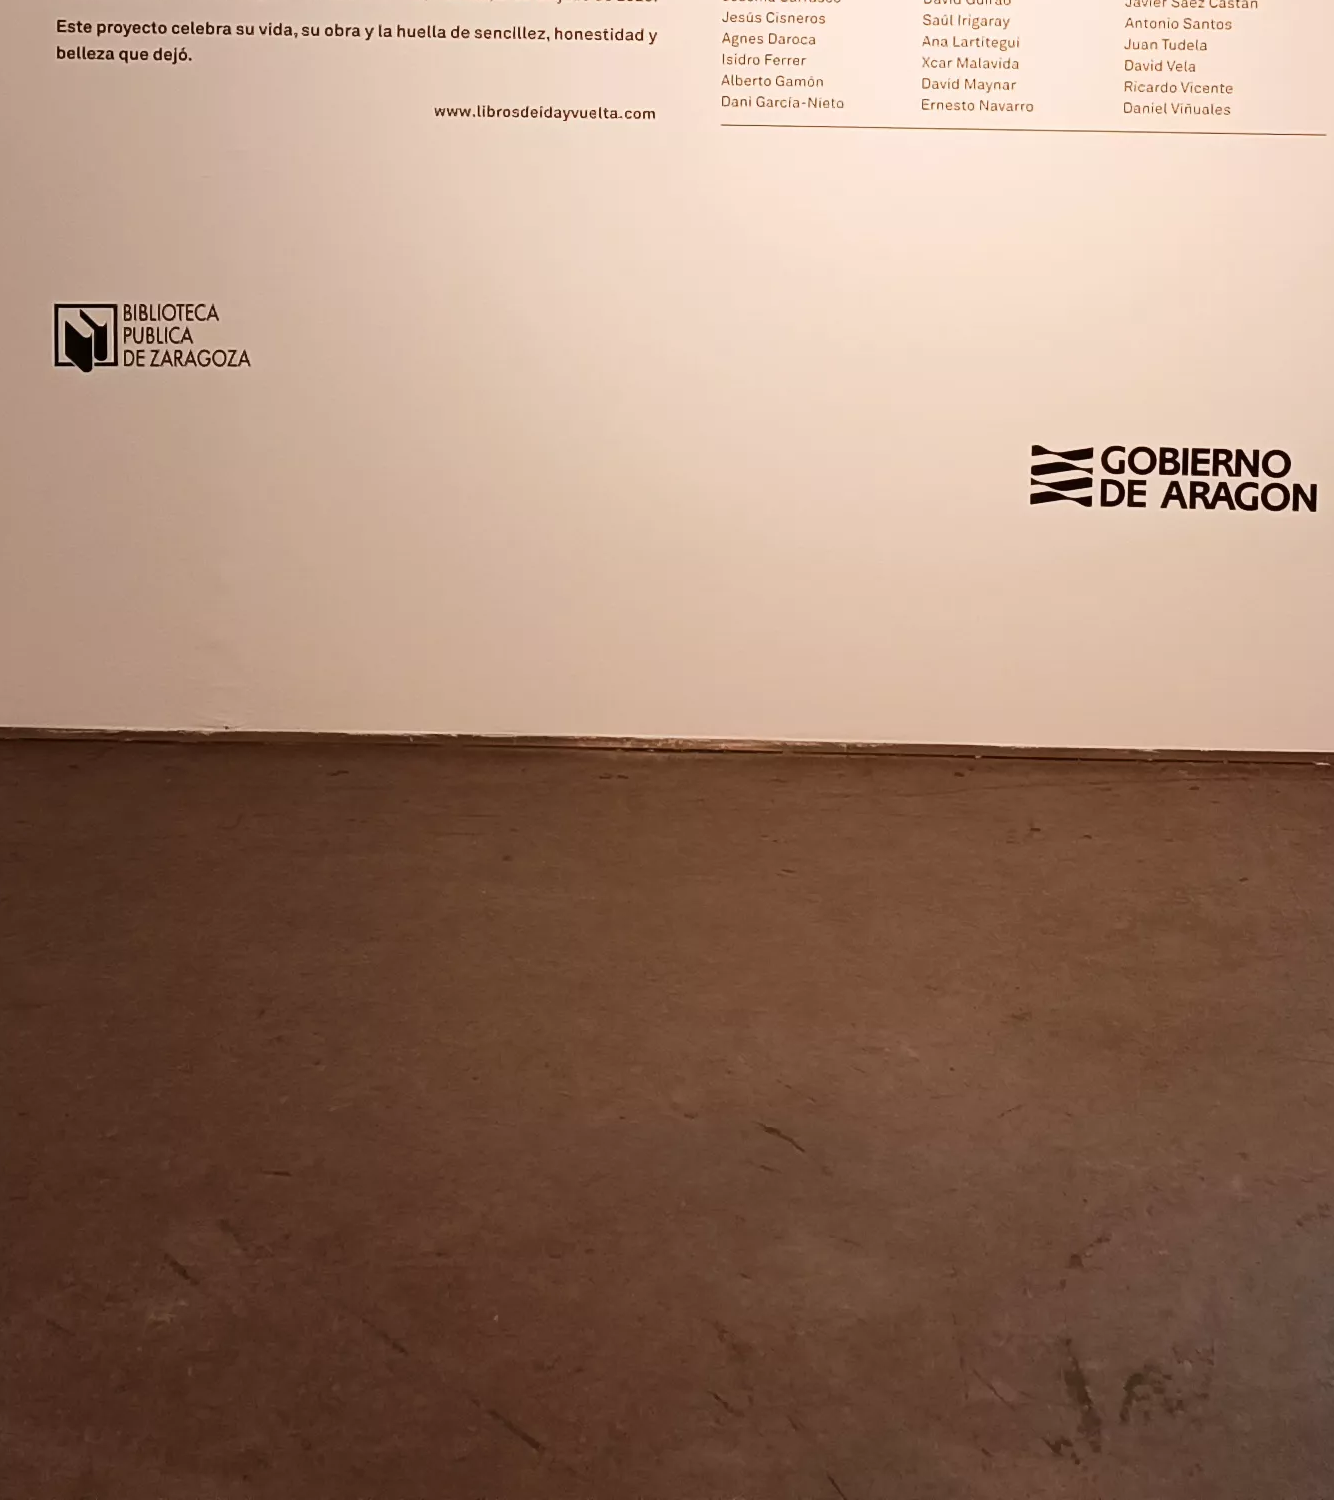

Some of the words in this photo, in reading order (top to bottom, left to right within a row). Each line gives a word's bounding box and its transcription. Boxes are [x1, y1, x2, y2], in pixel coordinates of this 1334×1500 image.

[56, 19, 93, 34] Este
[96, 20, 168, 38] proyecto
[171, 20, 232, 36] celebra
[235, 24, 255, 36] su
[258, 21, 299, 39] vida,
[300, 25, 320, 37] su
[324, 23, 361, 38] obra
[364, 26, 375, 42] y
[378, 23, 393, 38] la
[396, 23, 447, 39] huella
[450, 24, 471, 39] de
[474, 25, 551, 43] sencillez,
[554, 26, 645, 42] honestidad
[648, 31, 658, 46] y
[56, 45, 115, 61] belleza
[118, 49, 149, 64] que
[720, 73, 772, 87] Alberto
[921, 77, 960, 90] David
[964, 78, 1017, 94] Maynar
[1123, 80, 1178, 94] Ricardo
[1180, 81, 1234, 95] Vicente
[434, 104, 656, 122] www.librosdeidayvuelta.com
[122, 303, 219, 321] BIBLIOTECA
[122, 326, 193, 344] PUBLICA
[122, 349, 145, 366] DE
[150, 349, 251, 367] ZARAGOZA
[1100, 444, 1291, 478] GOBIERNO
[1099, 479, 1146, 507] DE
[1160, 480, 1317, 512] ARAGON
